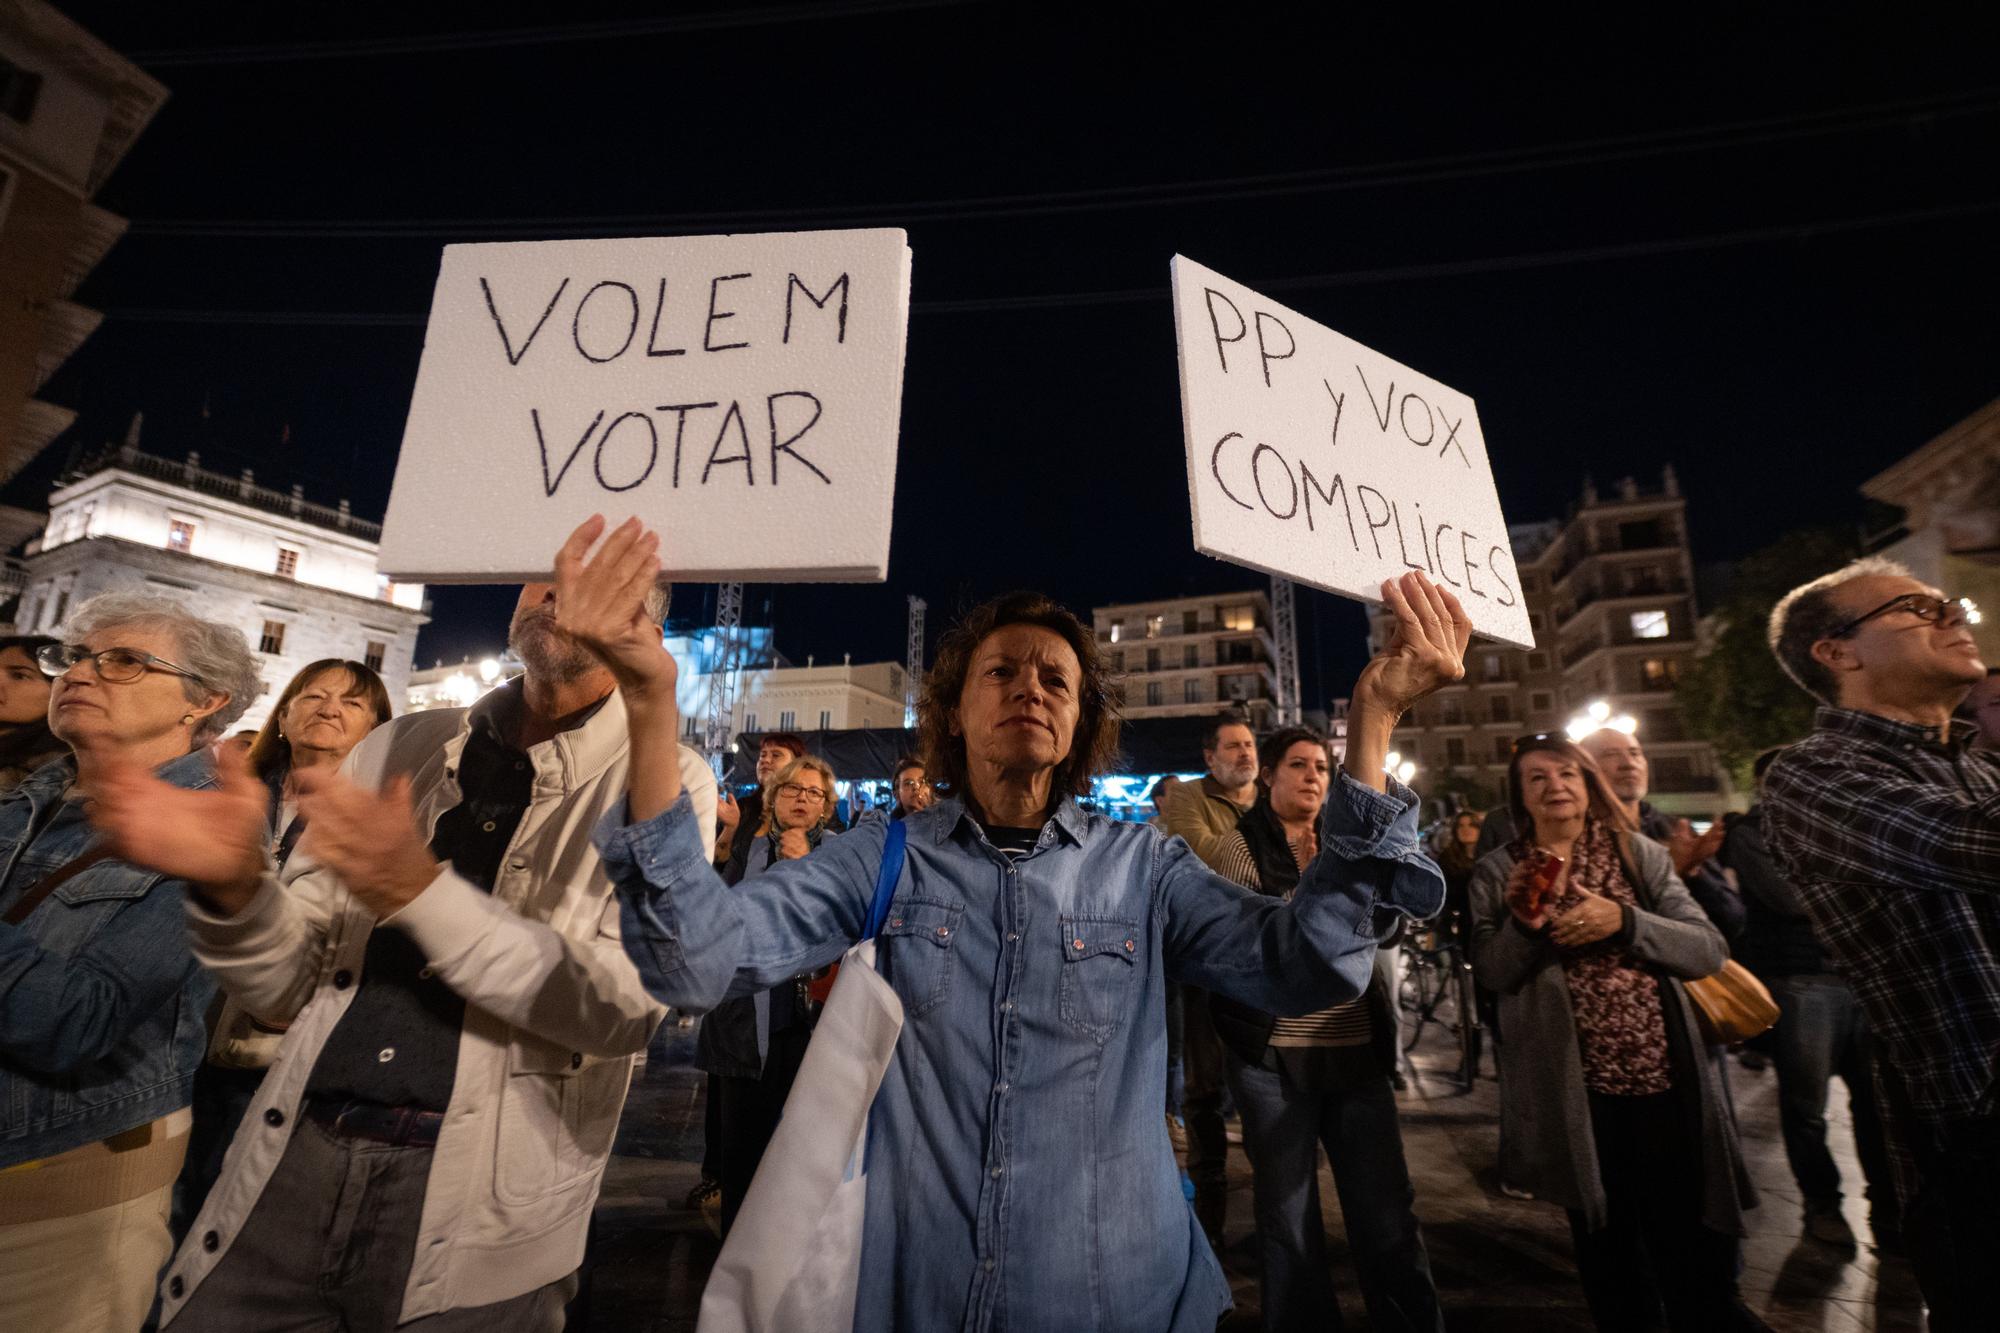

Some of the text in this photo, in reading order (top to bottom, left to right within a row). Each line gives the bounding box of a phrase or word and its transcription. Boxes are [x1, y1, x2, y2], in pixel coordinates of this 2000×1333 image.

[479, 272, 850, 366] VOLEM
[1204, 286, 1297, 388] PP
[1355, 364, 1472, 470] VOX
[531, 390, 832, 498] VOTAR
